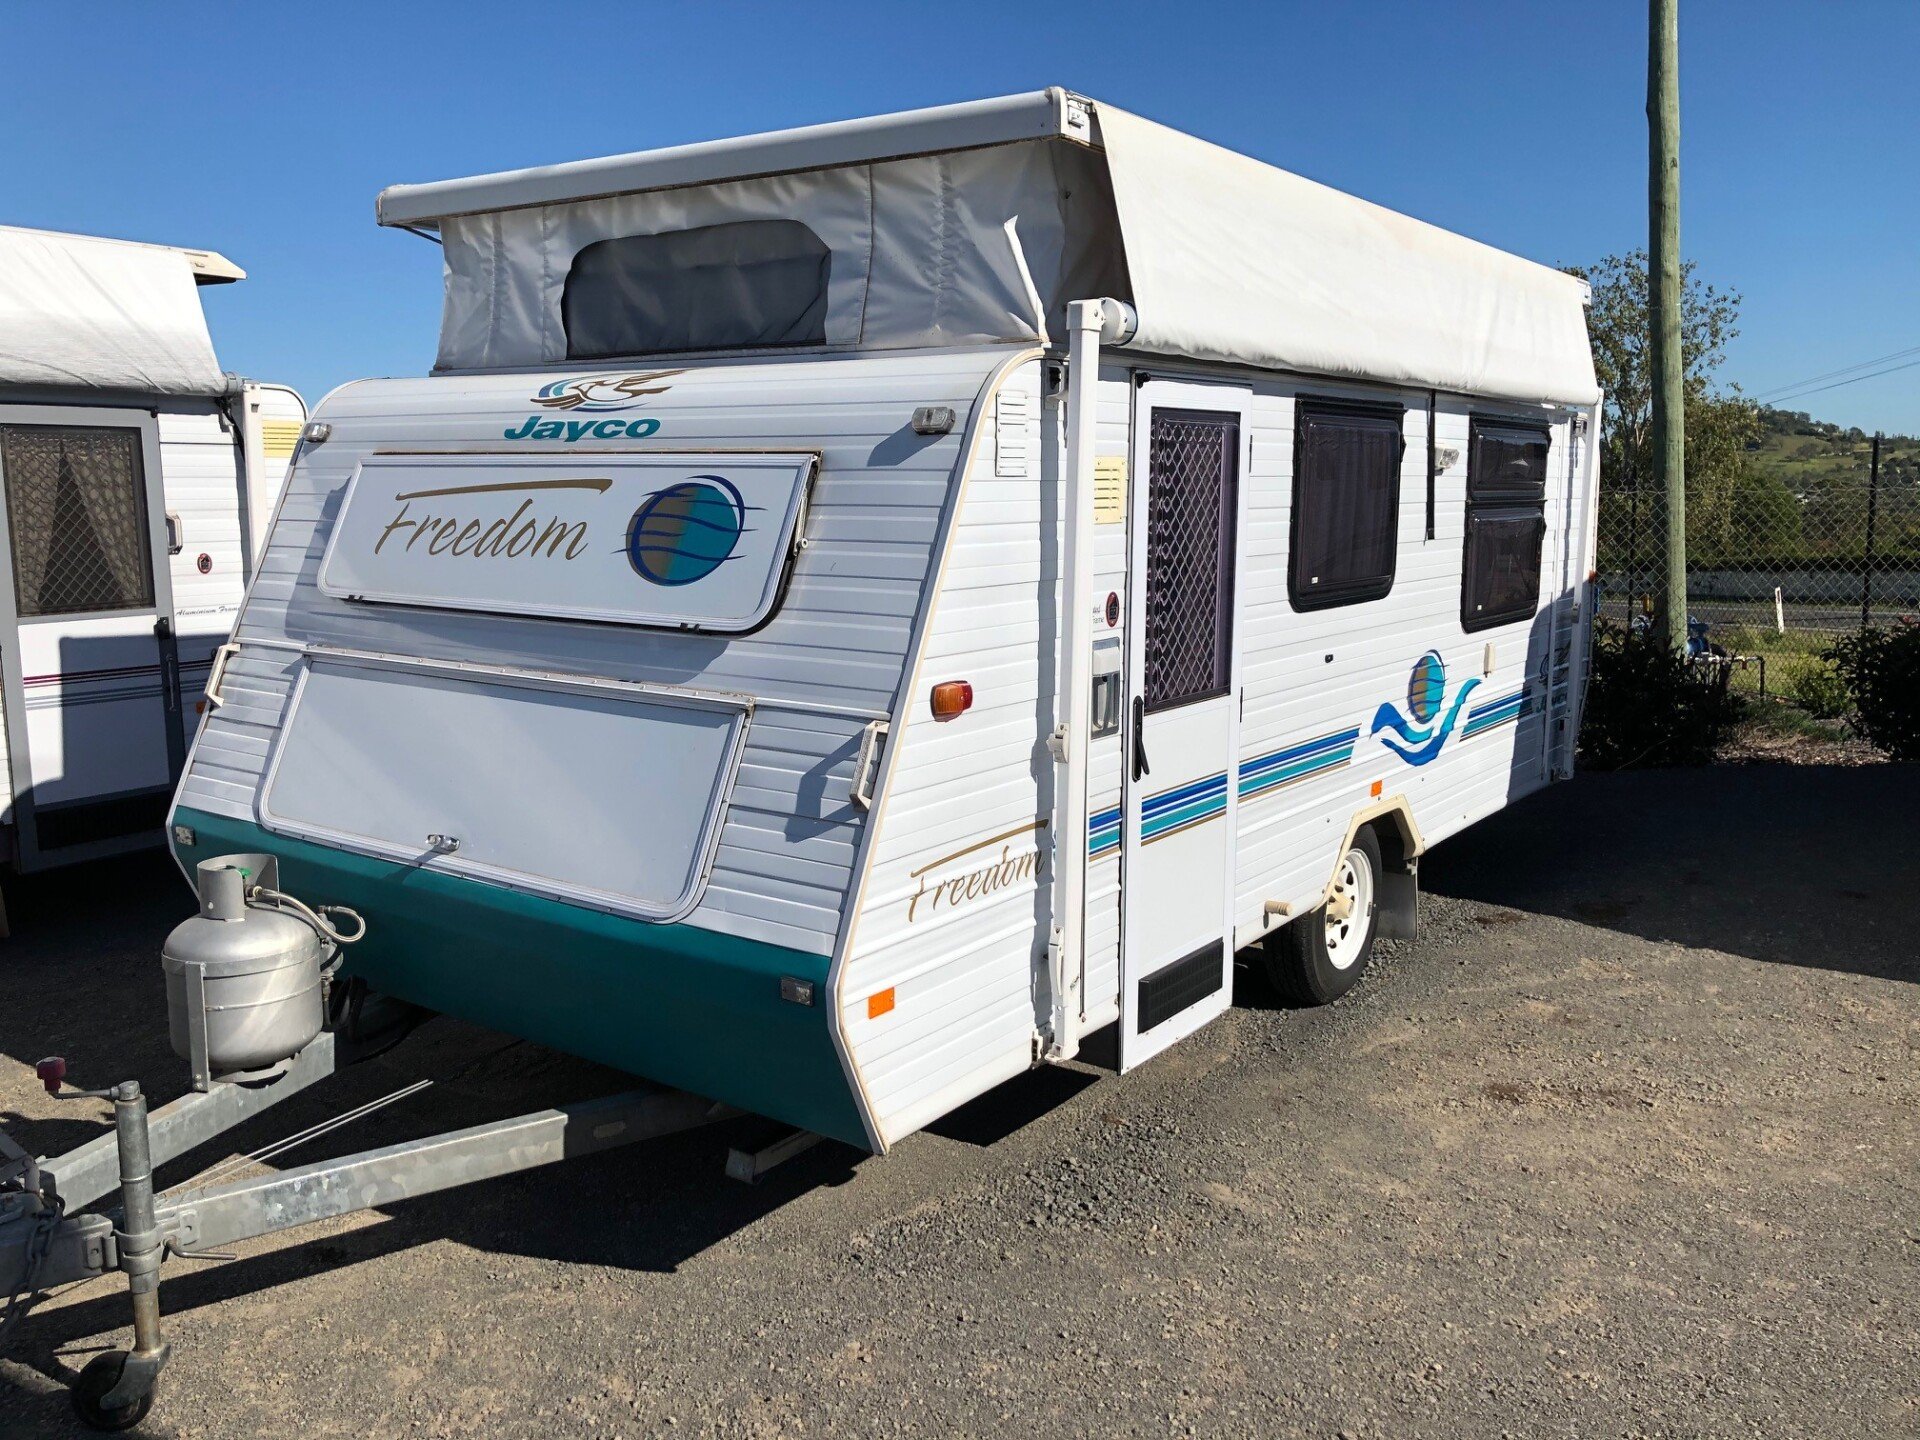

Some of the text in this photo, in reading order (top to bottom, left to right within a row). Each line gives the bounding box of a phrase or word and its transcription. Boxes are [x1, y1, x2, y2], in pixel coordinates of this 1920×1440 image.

[504, 415, 661, 442] Jayco
[374, 479, 613, 560] Freedom
[175, 608, 217, 617] Aluminium
[908, 819, 1049, 922] Freedom
